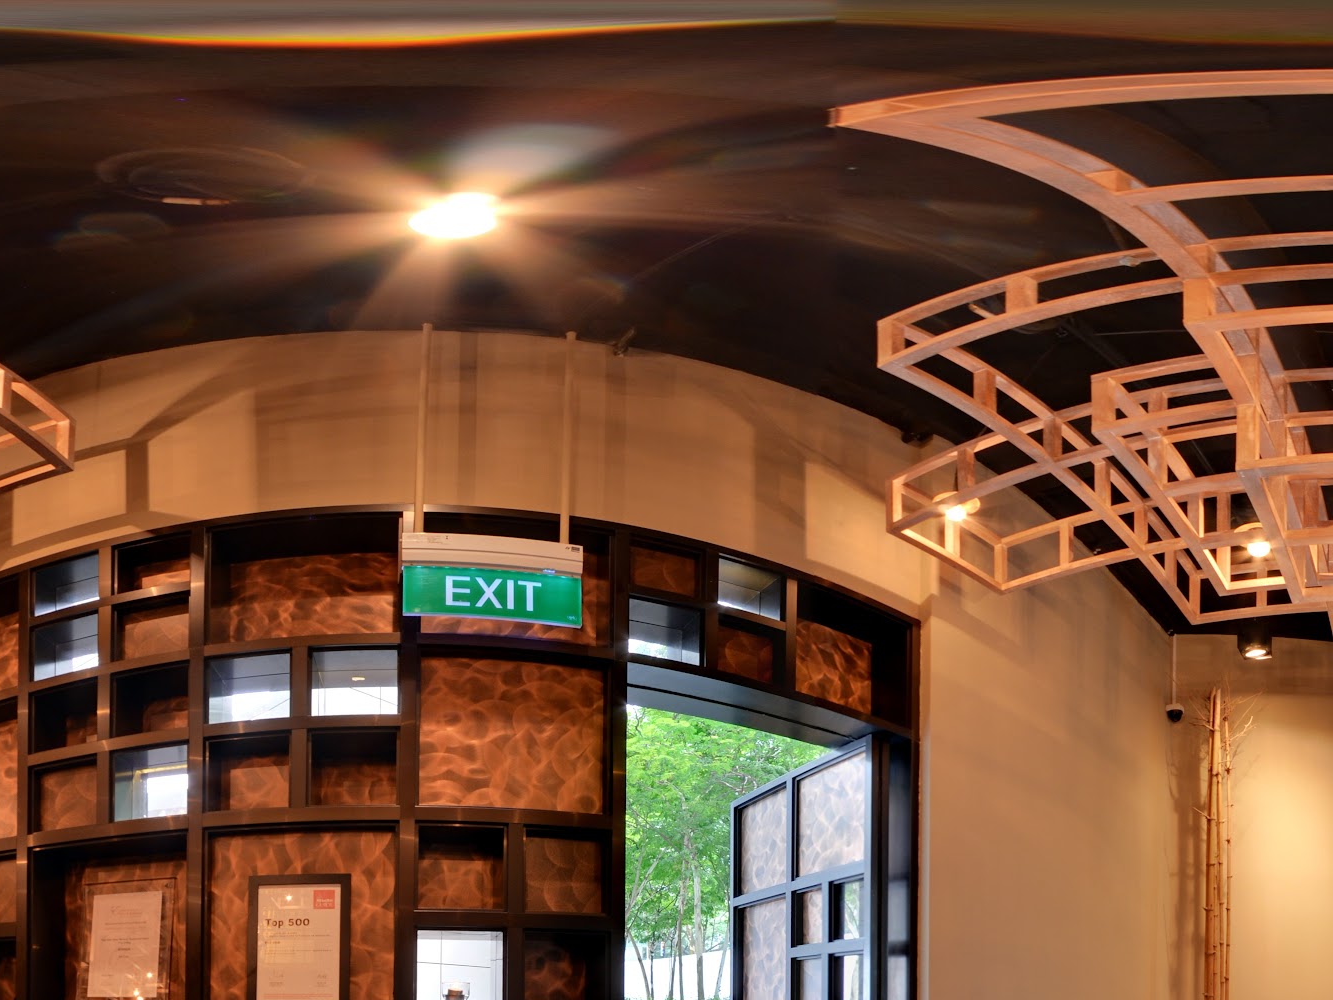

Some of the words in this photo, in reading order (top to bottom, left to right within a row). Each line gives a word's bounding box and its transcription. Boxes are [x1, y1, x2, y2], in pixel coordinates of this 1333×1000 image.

[445, 575, 542, 612] EXIT
[265, 919, 284, 928] Top
[288, 918, 310, 926] 500
